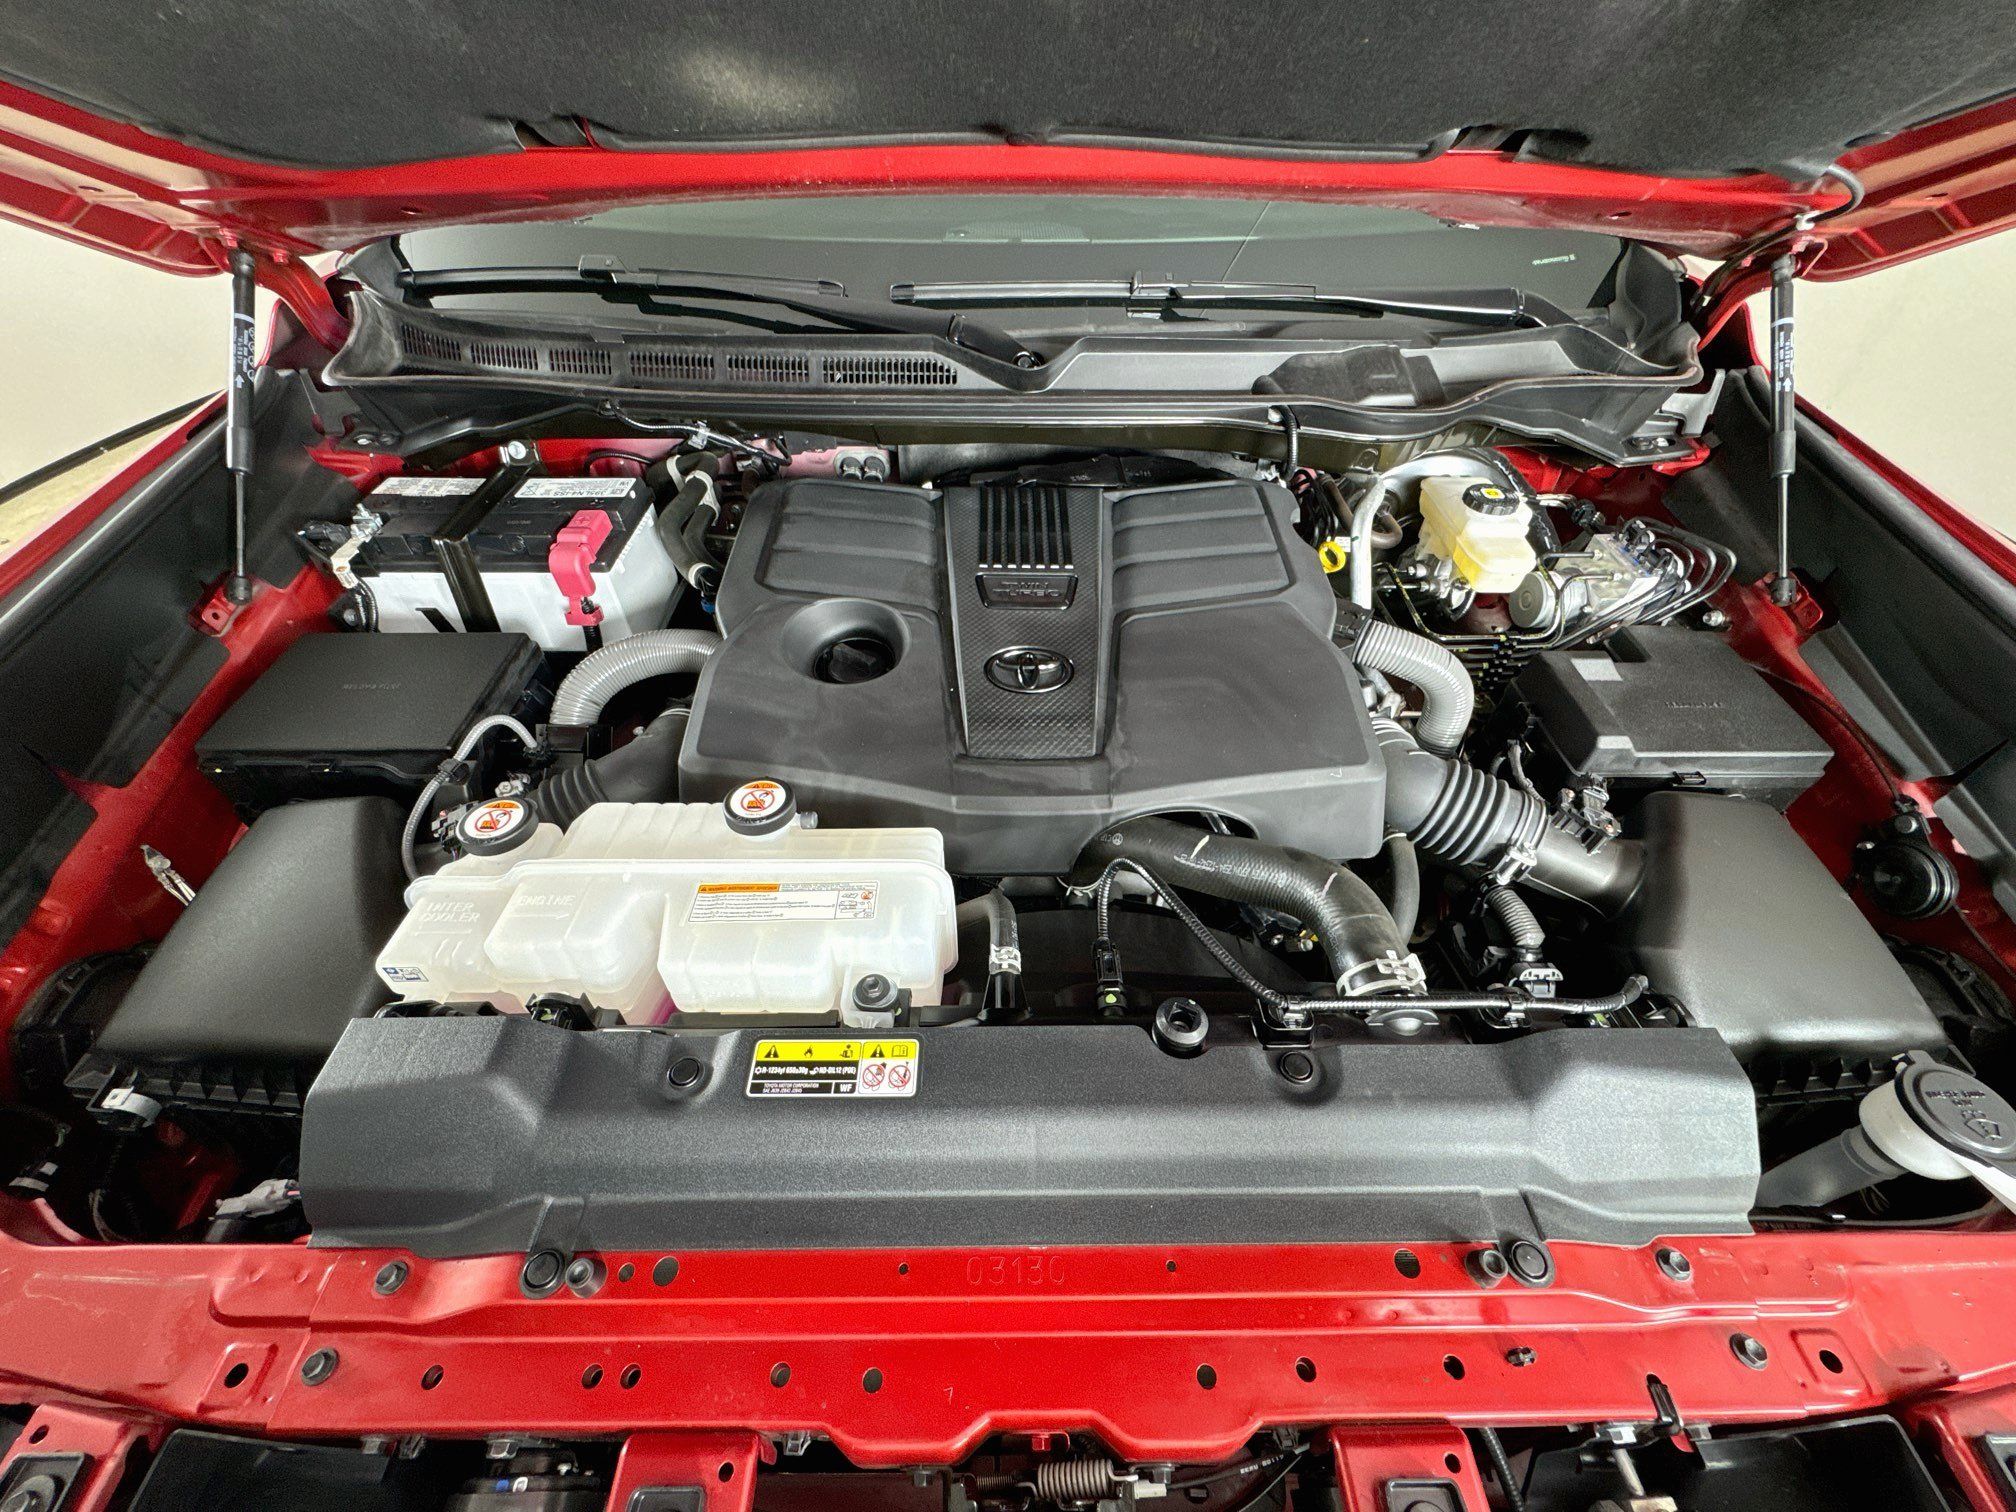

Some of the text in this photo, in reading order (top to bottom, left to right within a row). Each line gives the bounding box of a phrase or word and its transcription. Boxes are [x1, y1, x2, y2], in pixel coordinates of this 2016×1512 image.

[519, 894, 576, 906] ENGINE
[426, 901, 475, 912] INTER
[418, 912, 481, 923] COOLER
[840, 1083, 853, 1092] WF
[966, 1255, 1065, 1285] 03130
